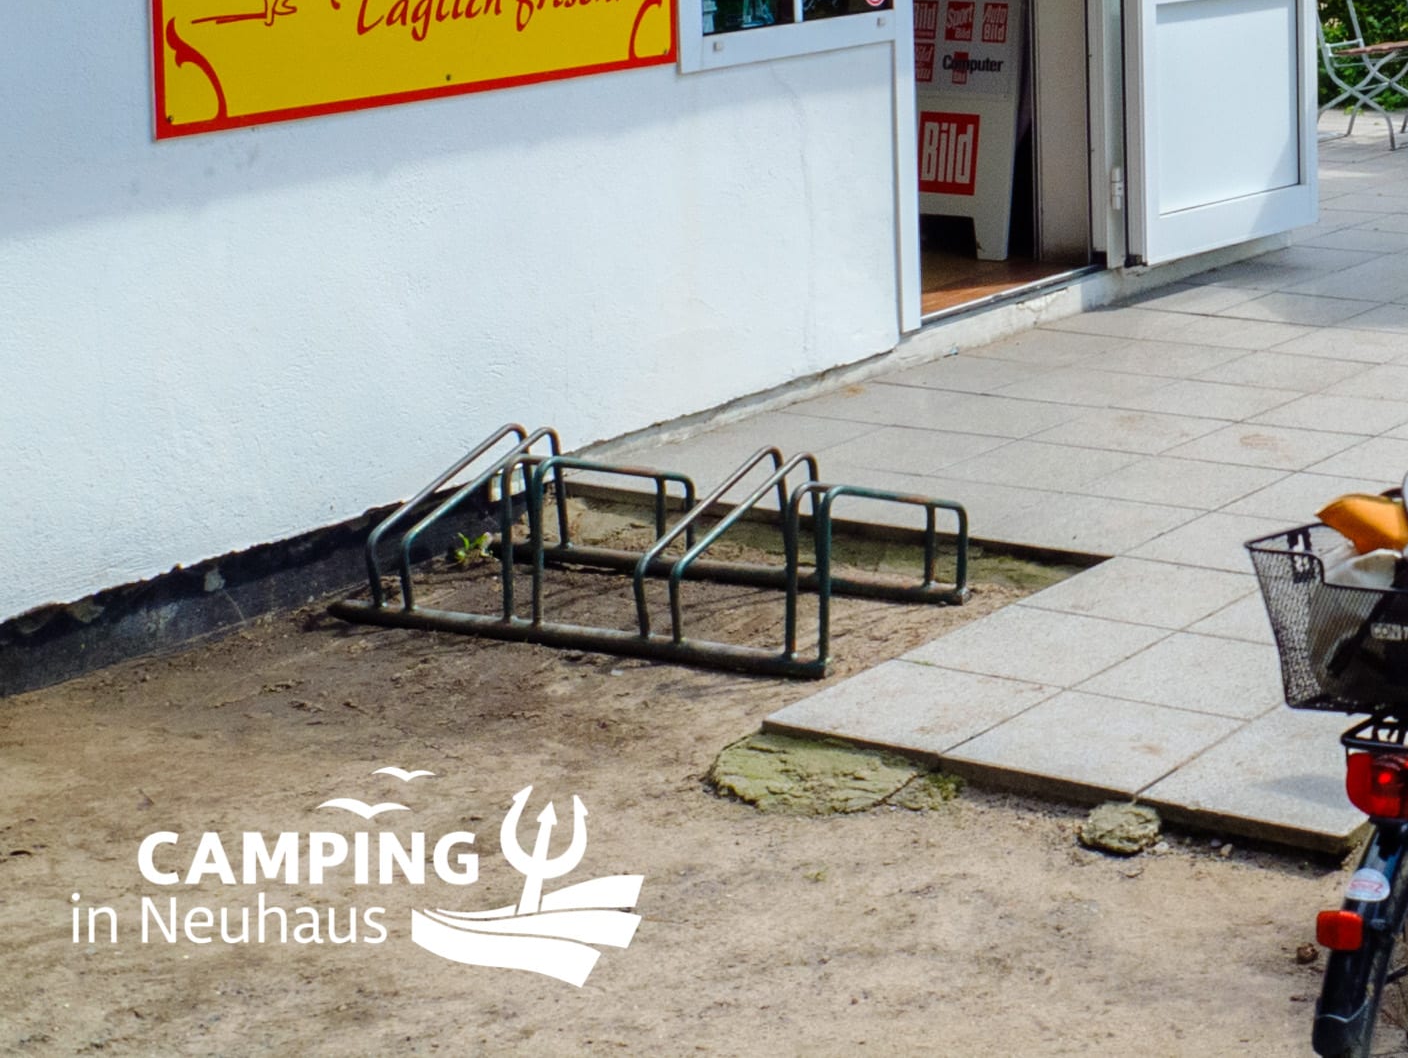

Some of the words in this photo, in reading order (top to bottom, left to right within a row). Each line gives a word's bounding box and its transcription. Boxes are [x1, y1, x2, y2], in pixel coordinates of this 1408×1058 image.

[914, 2, 938, 30] ild
[984, 4, 1008, 24] Auto
[982, 23, 1006, 41] Bild
[942, 54, 1004, 75] Computer
[920, 121, 975, 184] Bild
